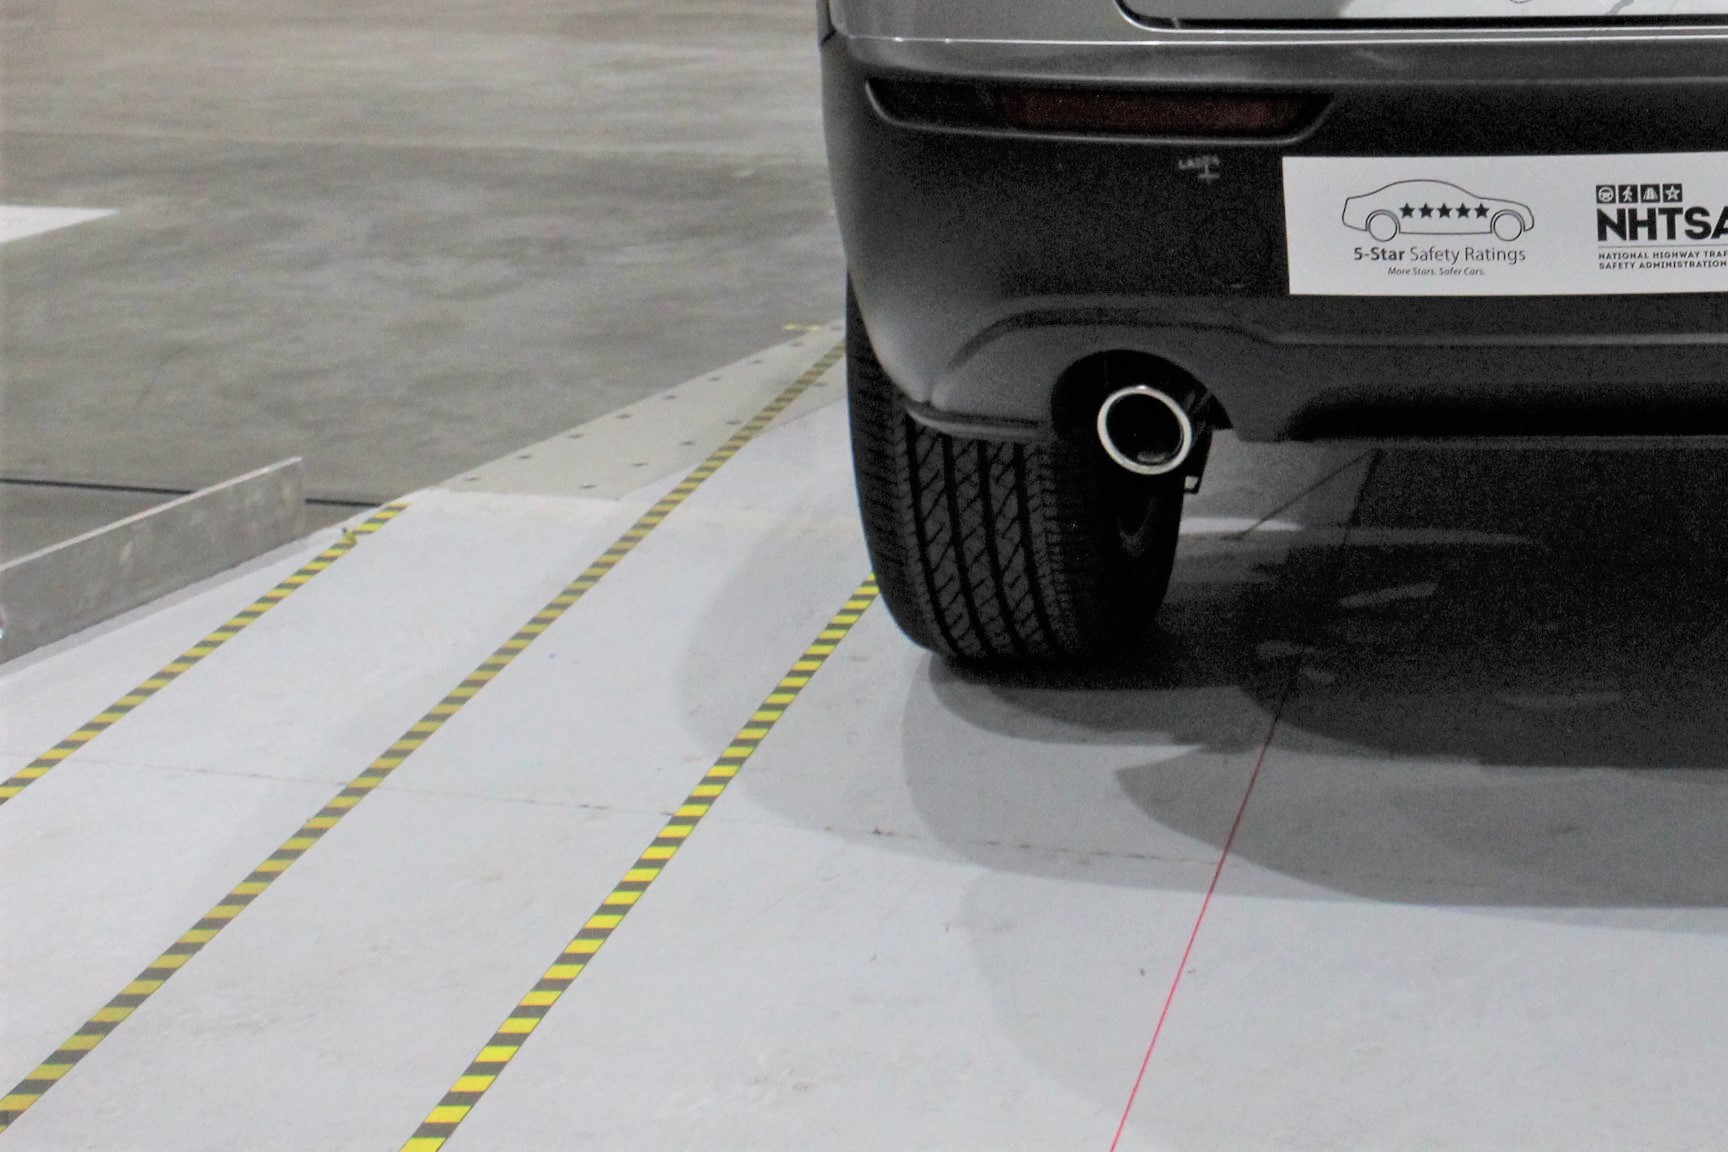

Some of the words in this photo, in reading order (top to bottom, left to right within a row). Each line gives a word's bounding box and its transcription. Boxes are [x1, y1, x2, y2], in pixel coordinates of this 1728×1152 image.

[1353, 246, 1405, 262] 5-Star
[1409, 246, 1460, 265] Safety
[1464, 246, 1527, 265] Ratings
[1598, 251, 1650, 261] NATIONAL
[1652, 250, 1701, 260] HIGHWAY
[1599, 261, 1636, 271] SAFETY
[1638, 259, 1728, 270] ADMINISTRATION
[1387, 266, 1411, 277] More
[1438, 266, 1462, 277] Safer
